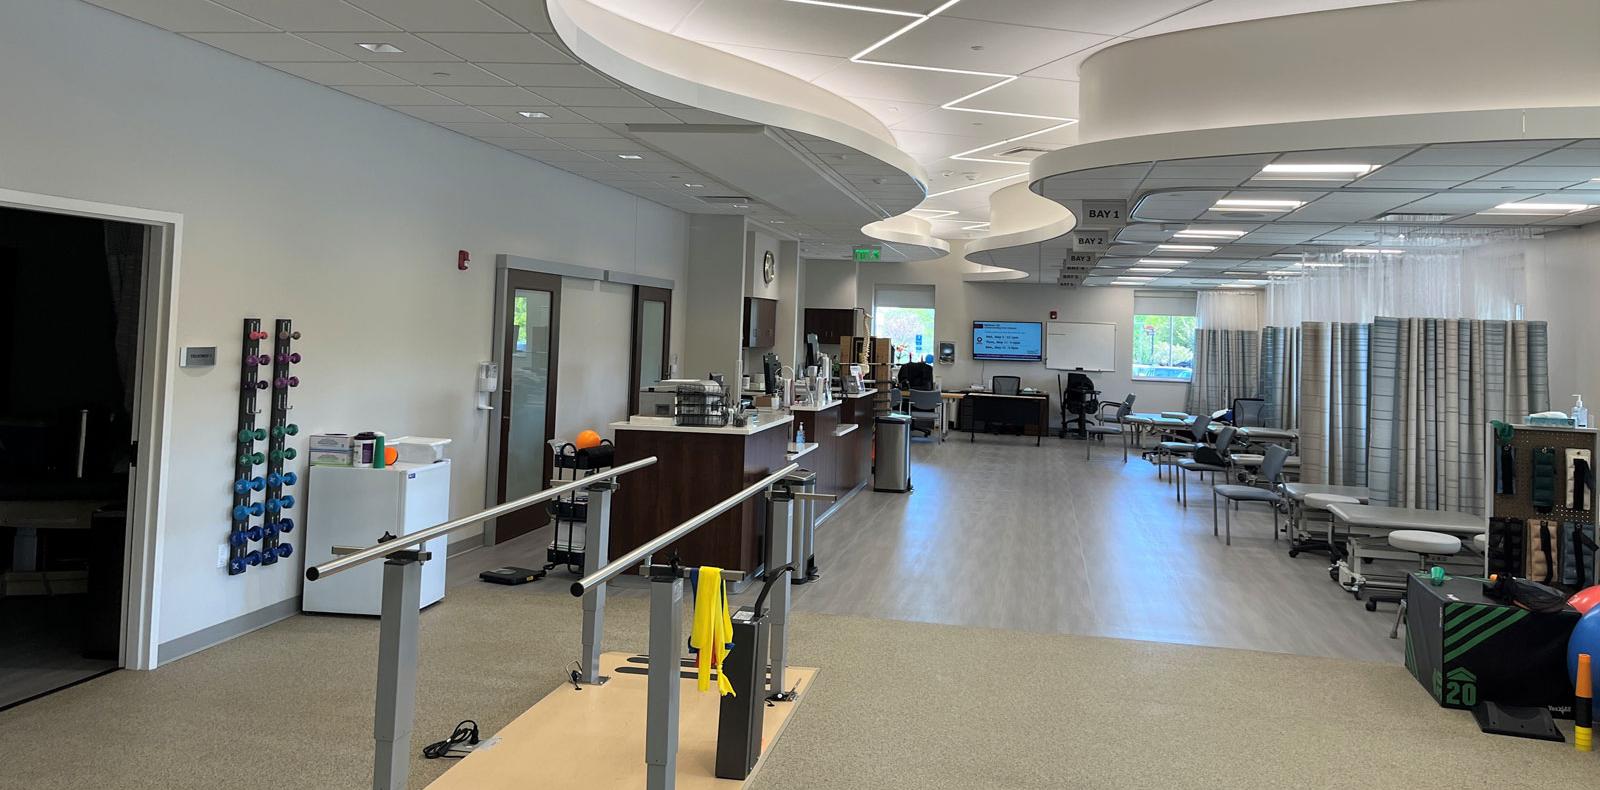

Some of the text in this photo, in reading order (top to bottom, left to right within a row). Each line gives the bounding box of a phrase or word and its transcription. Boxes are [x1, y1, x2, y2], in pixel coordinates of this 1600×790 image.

[1089, 210, 1119, 219] BAY 1
[1446, 681, 1477, 706] 20
